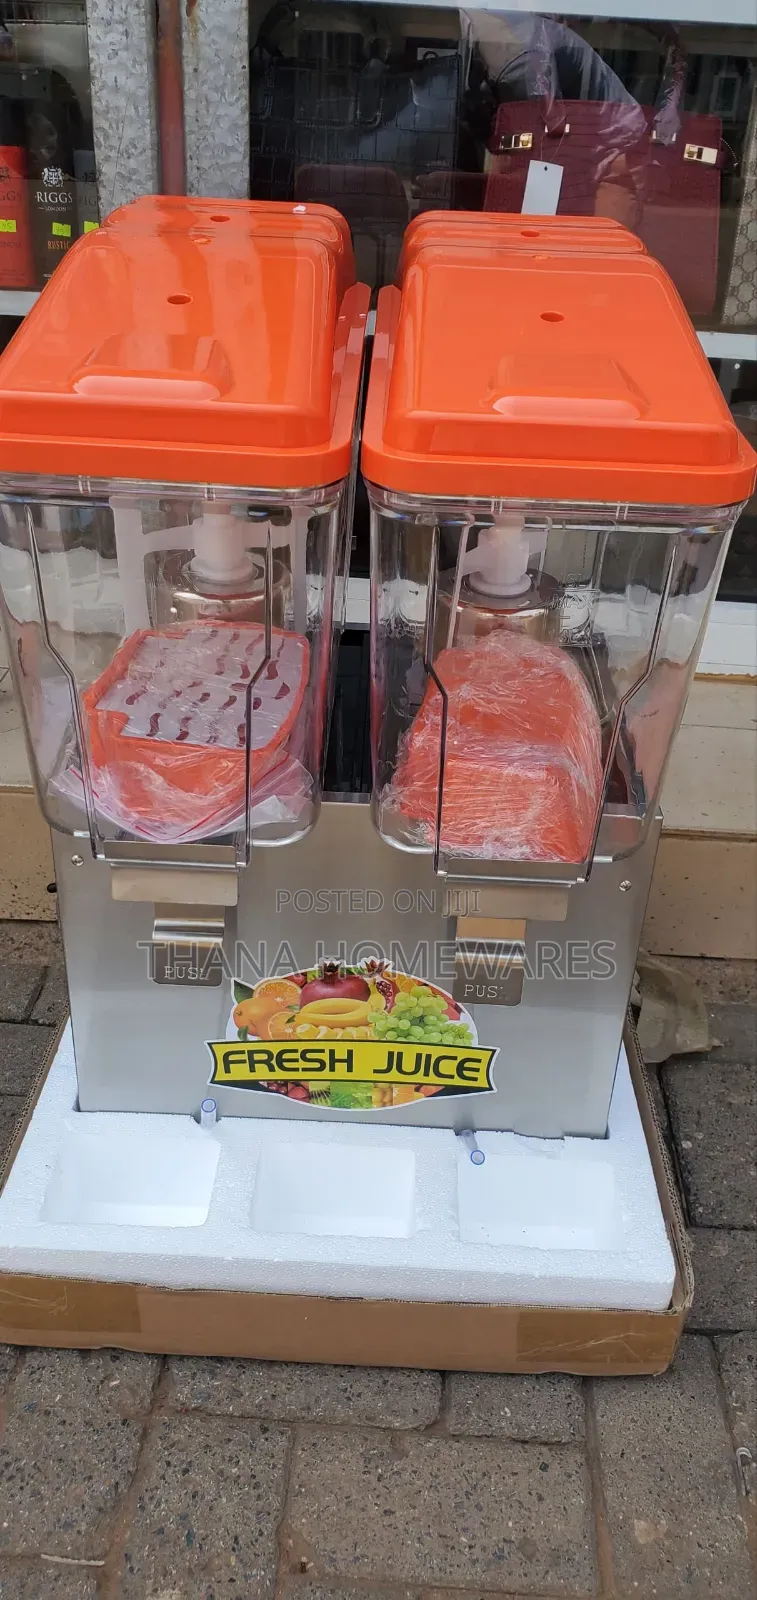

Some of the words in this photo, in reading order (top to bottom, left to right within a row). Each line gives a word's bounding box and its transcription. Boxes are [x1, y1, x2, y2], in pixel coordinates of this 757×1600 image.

[36, 191, 73, 204] RIGGS
[222, 1048, 355, 1074] FRESH
[372, 1050, 483, 1082] JUICE
